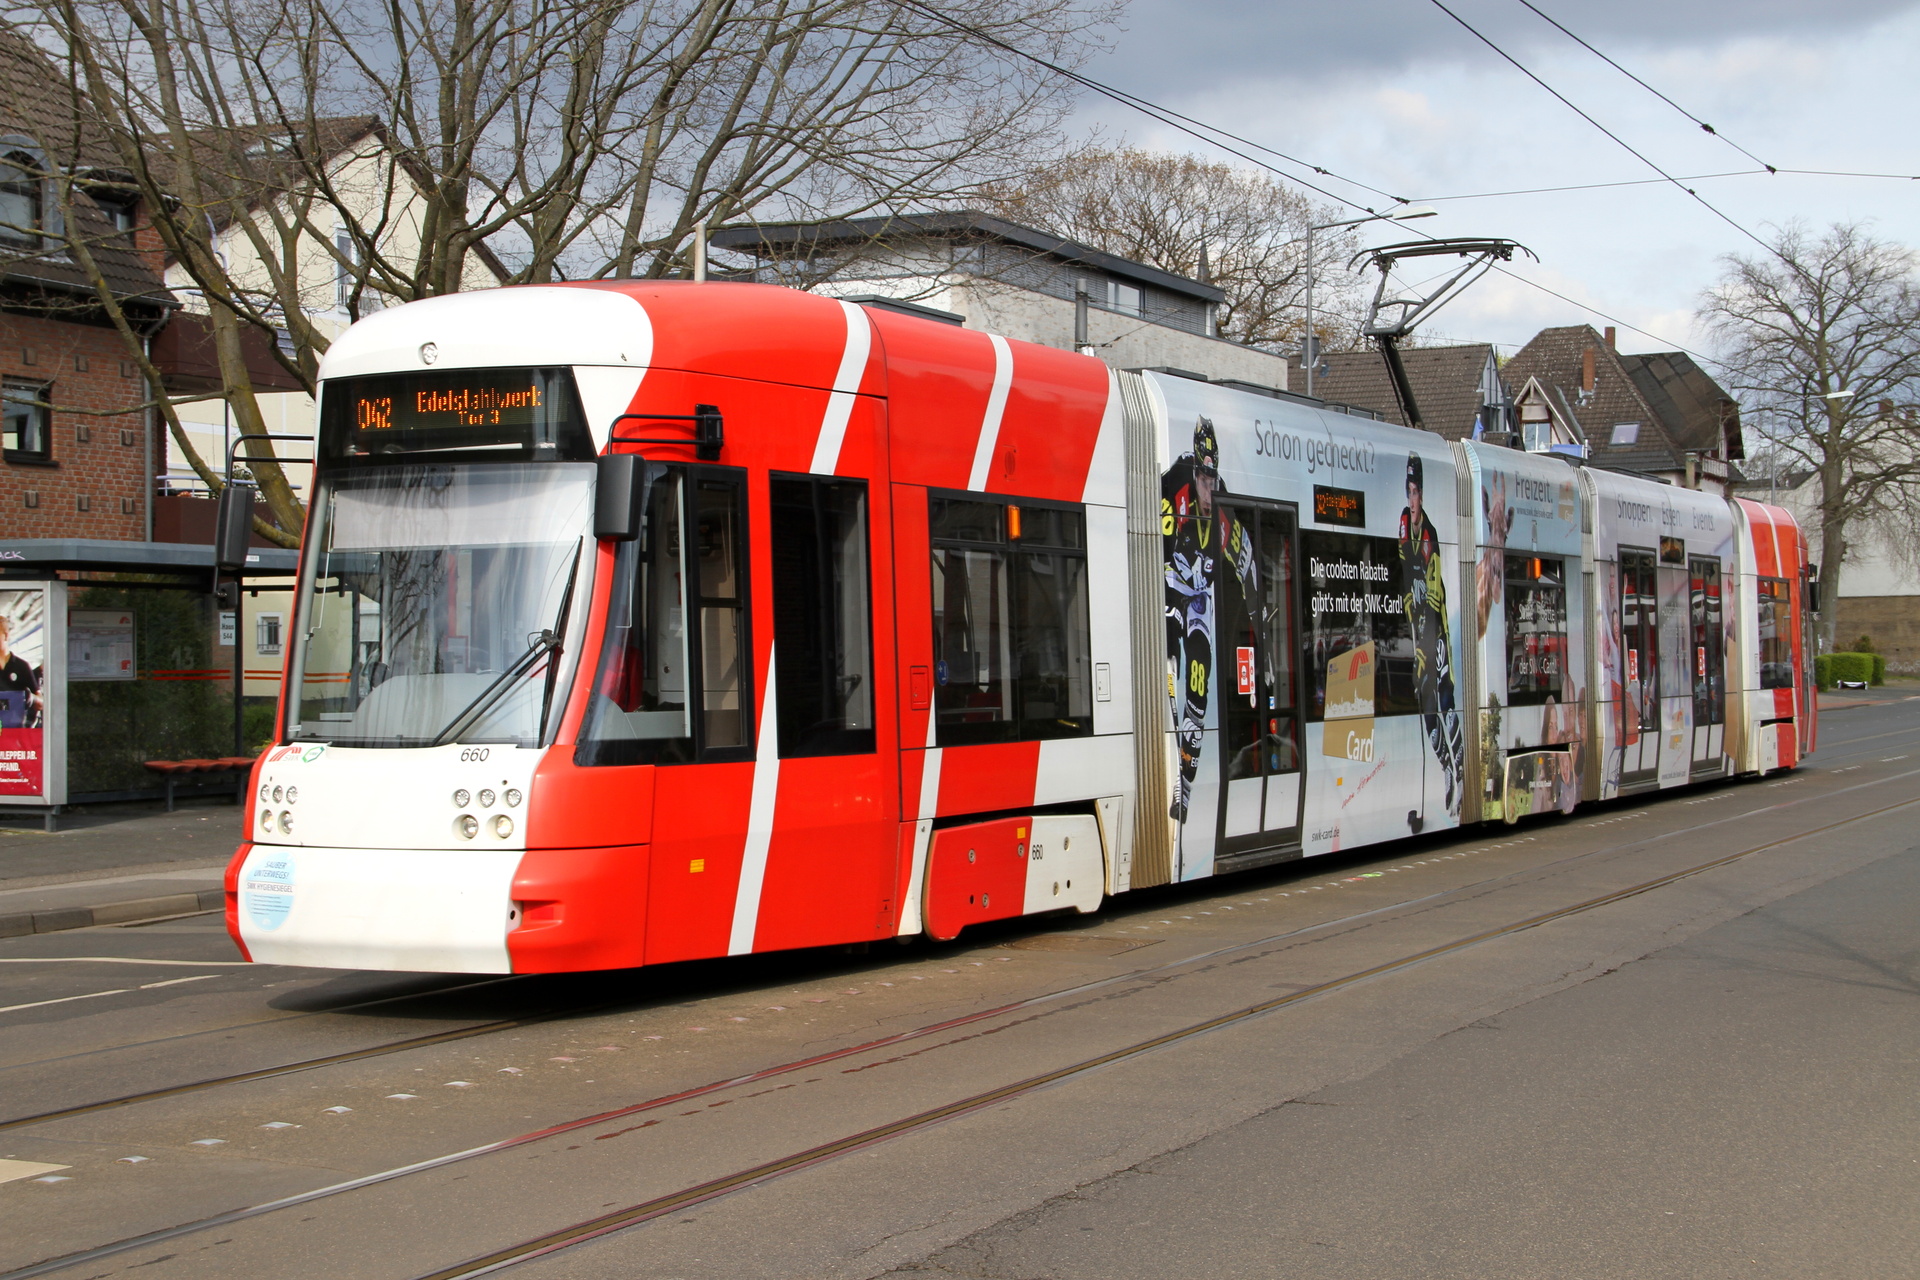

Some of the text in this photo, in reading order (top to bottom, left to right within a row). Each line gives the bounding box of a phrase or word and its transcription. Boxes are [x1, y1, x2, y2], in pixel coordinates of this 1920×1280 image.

[417, 385, 542, 413] Edelstahlwerk
[1254, 419, 1375, 474] Schon gecheckt?
[1514, 470, 1554, 504] Freizeit.
[1617, 493, 1716, 532] Shoppen. Essen. Events.
[1310, 557, 1389, 582] Die coolsten Rabatte
[1311, 590, 1403, 618] gibt's mit der SWK-Card!
[222, 632, 233, 640] 544
[1190, 659, 1205, 697] 88
[460, 748, 490, 762] 660
[1346, 729, 1375, 763] Card
[1311, 822, 1340, 842] swk-card.de
[1031, 844, 1044, 860] 660
[253, 869, 290, 879] UNTERWEGS!
[264, 861, 288, 869] SAUBER
[257, 883, 294, 893] HYGIENESIEGEL
